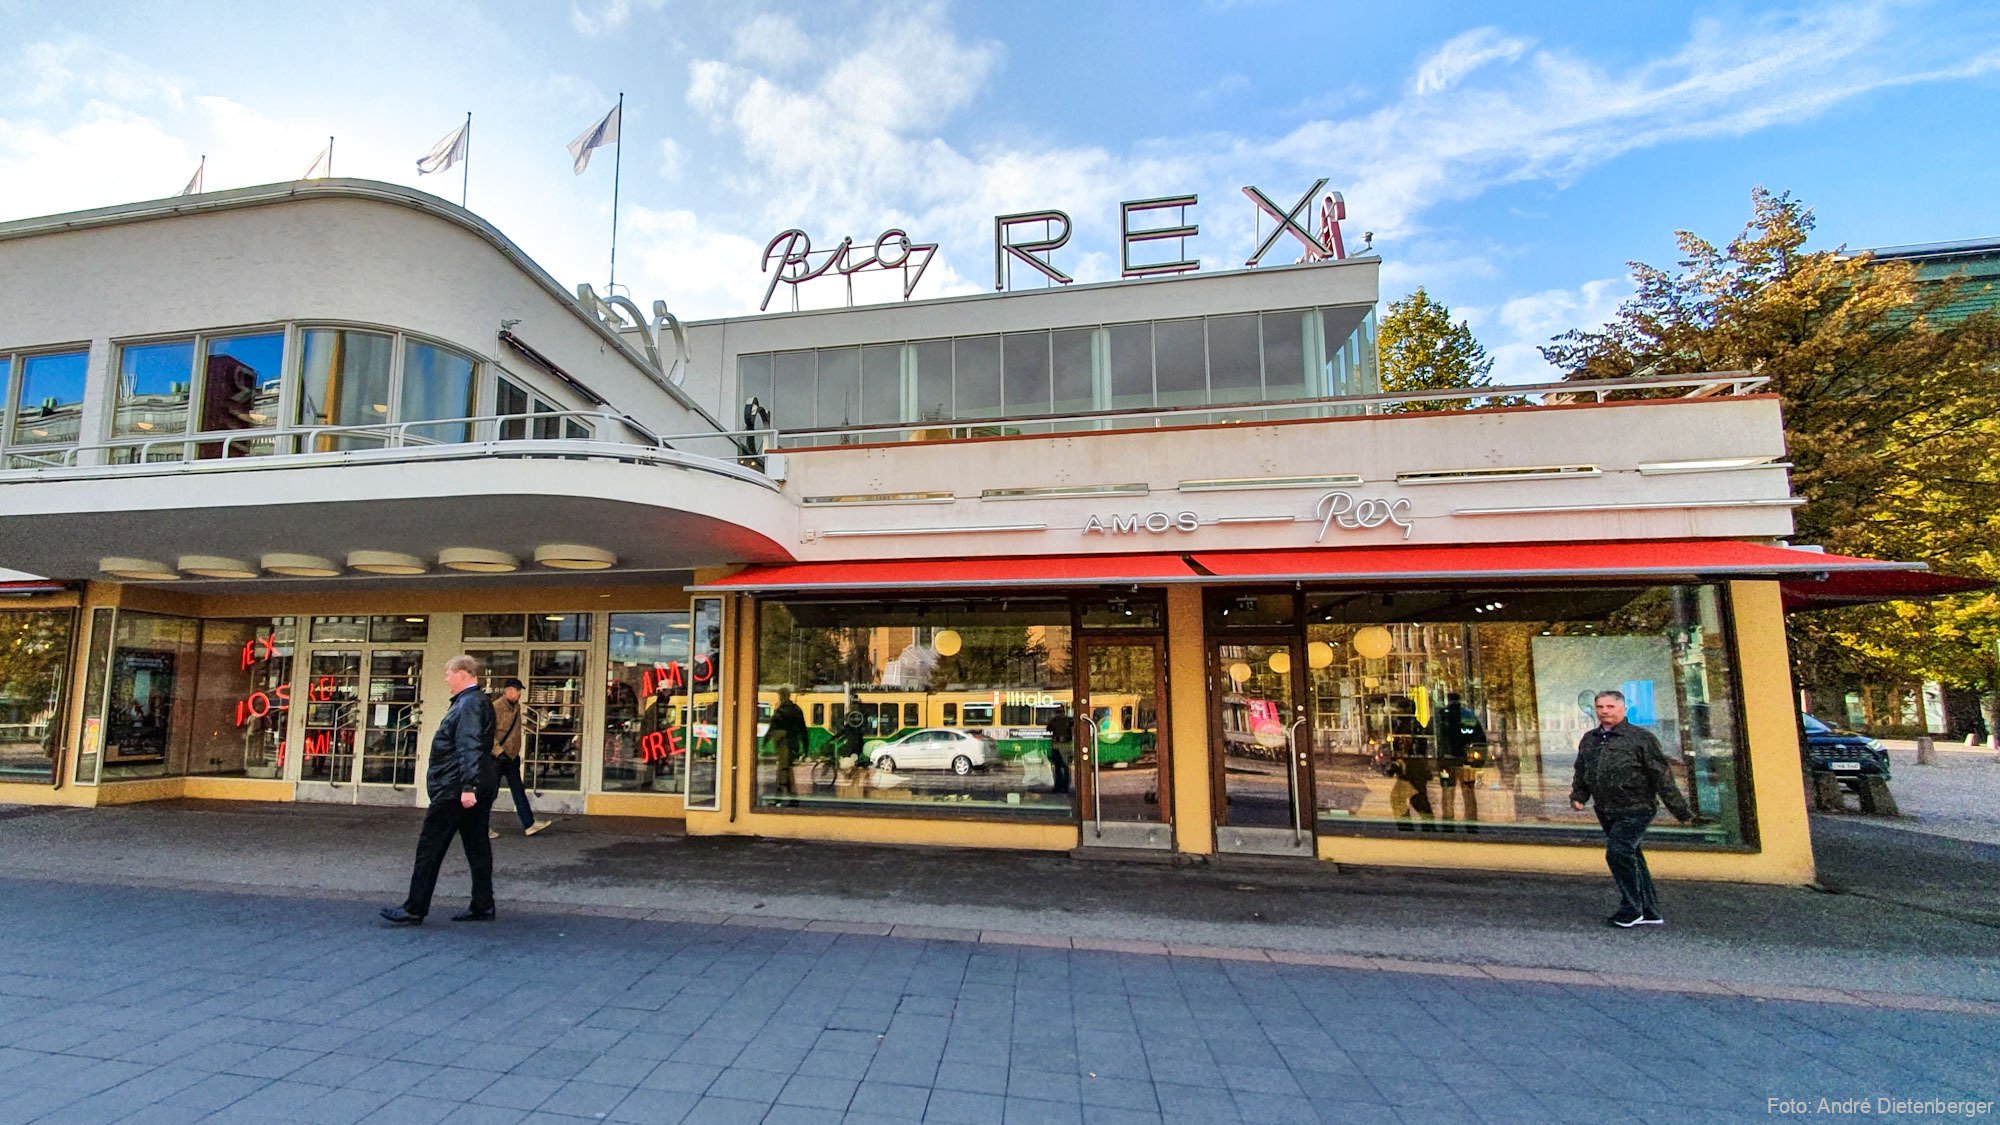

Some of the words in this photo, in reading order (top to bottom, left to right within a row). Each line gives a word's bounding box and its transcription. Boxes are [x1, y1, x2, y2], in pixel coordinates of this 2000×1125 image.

[761, 228, 939, 312] Bio
[994, 178, 1332, 290] REX
[1082, 512, 1199, 536] AMOS
[1316, 491, 1415, 543] Rex
